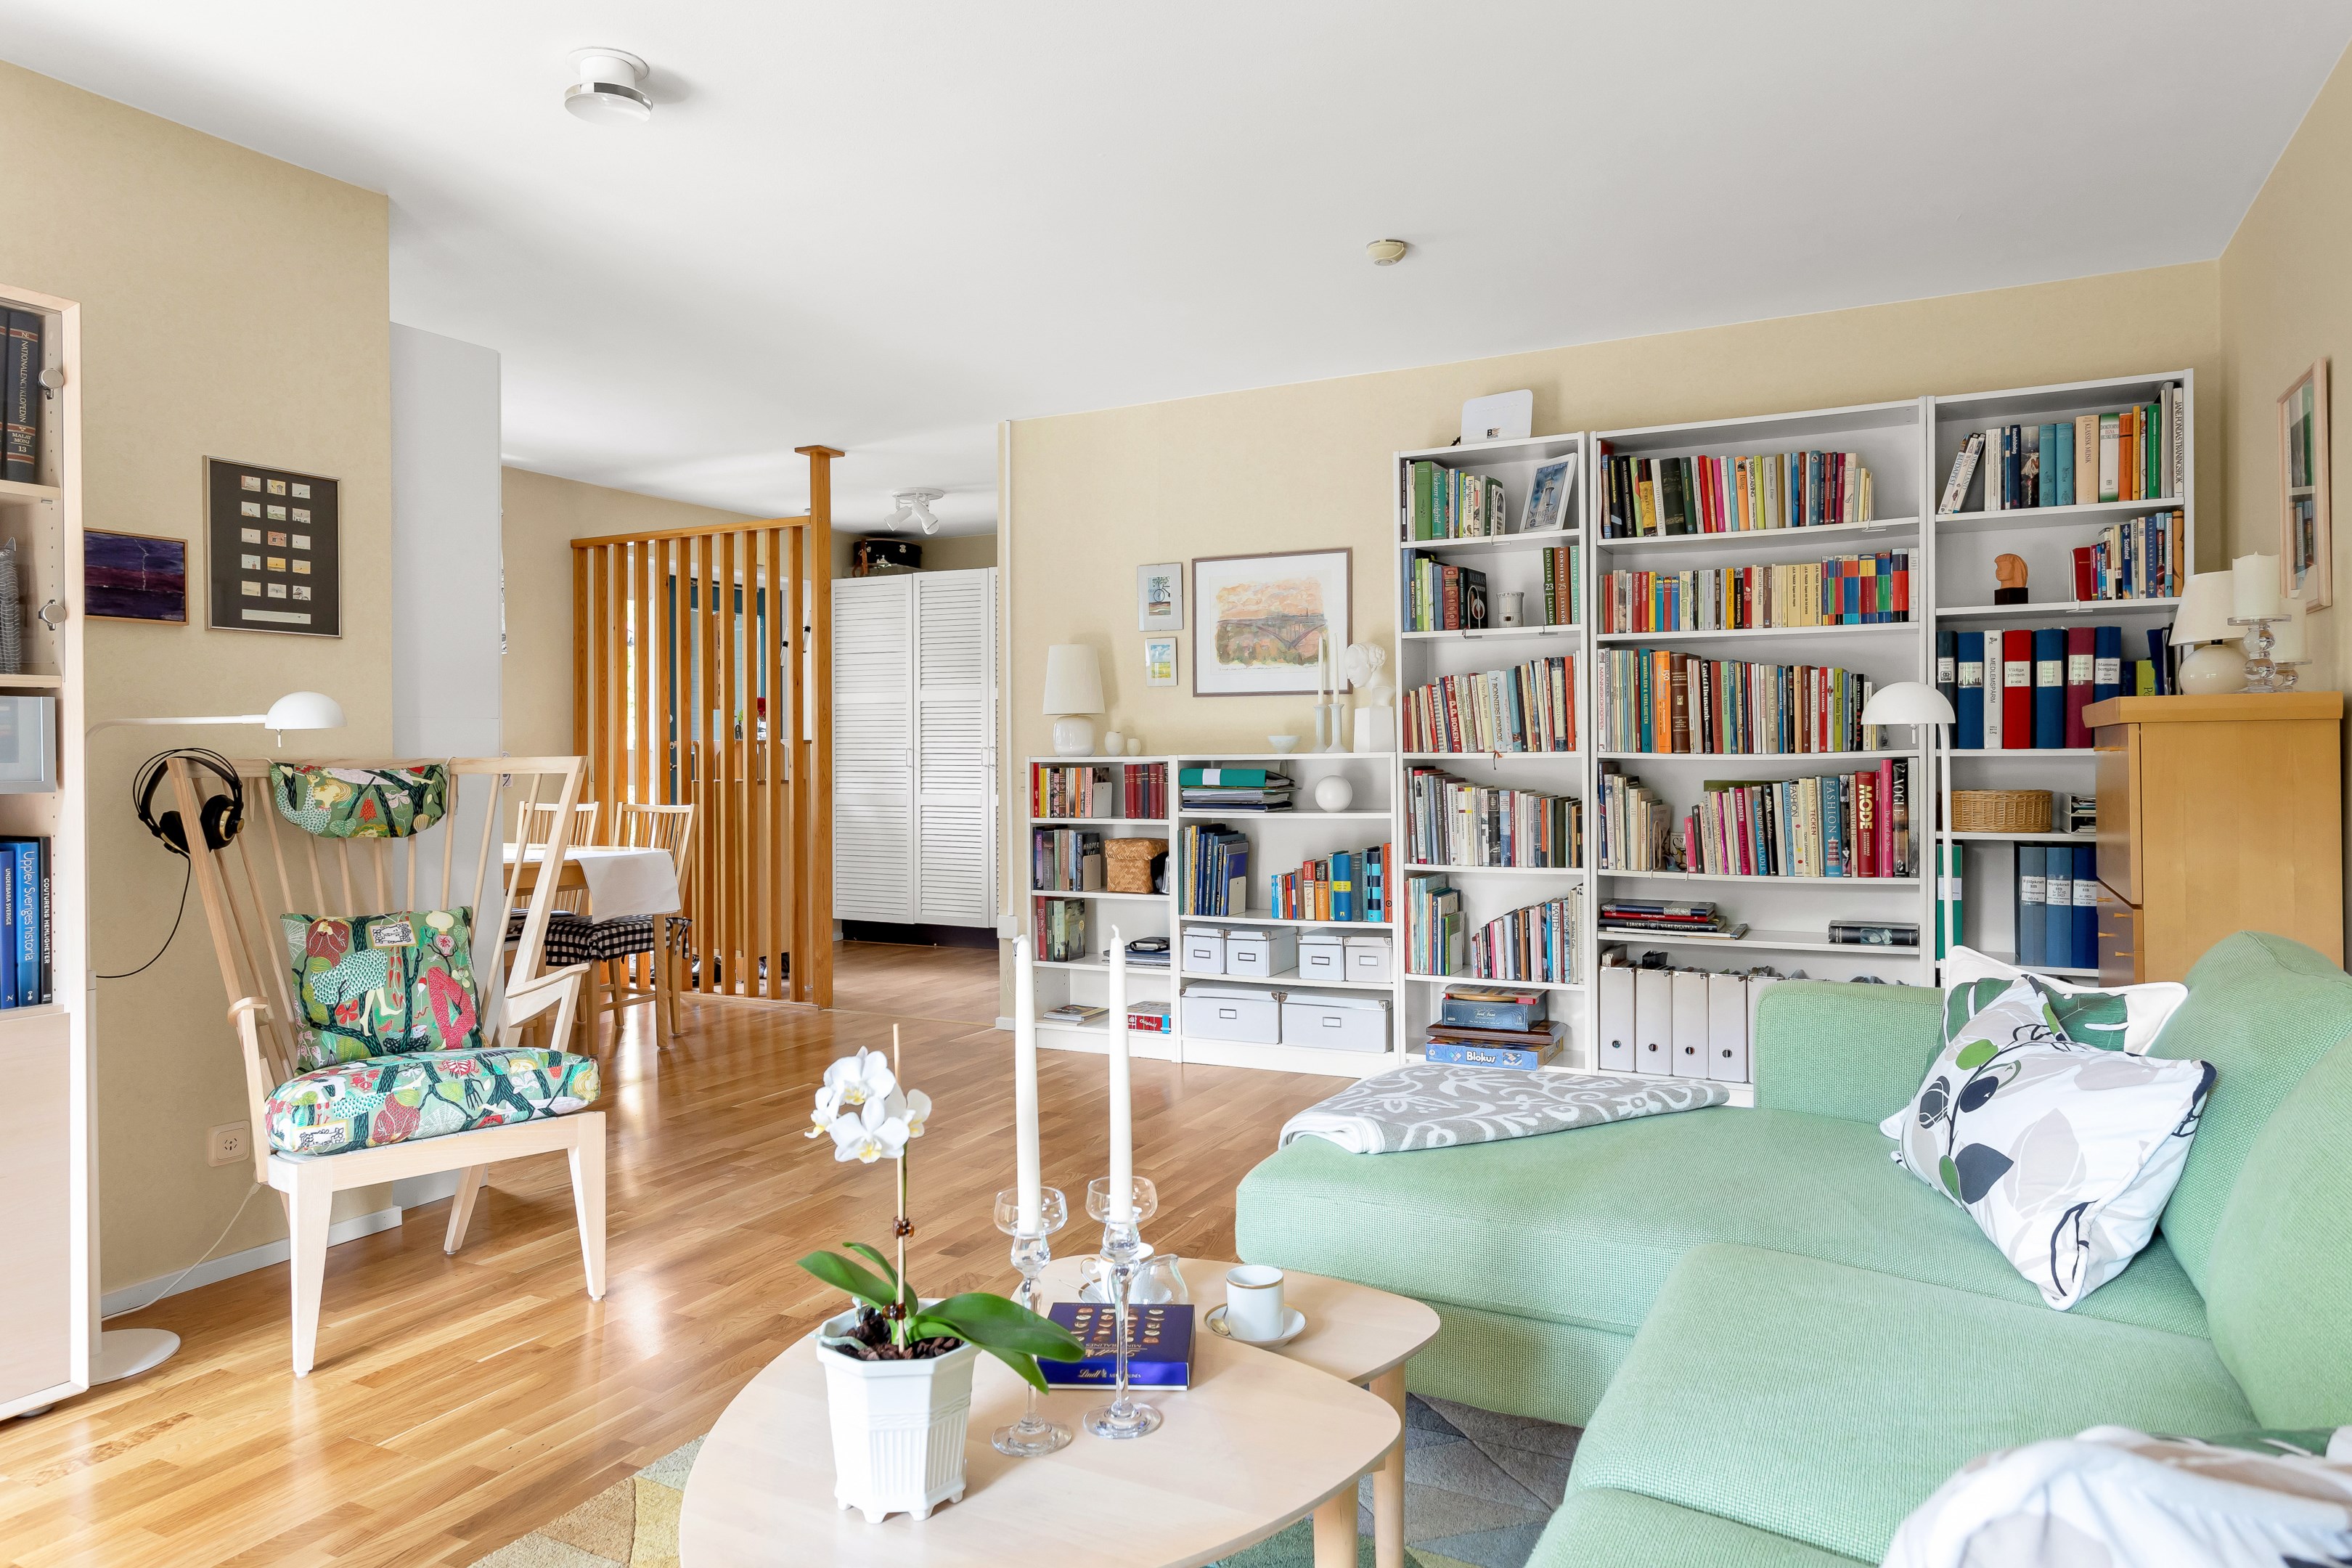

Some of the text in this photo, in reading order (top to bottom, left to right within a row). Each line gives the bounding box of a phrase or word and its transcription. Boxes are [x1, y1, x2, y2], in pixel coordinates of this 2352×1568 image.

[19, 340, 28, 422] NATIONALENCYKLOPEDIN
[1948, 454, 1964, 487] BUDAPEST
[1961, 455, 1979, 490] SKOTTLAND
[1491, 683, 1500, 715] BONNIERS
[1790, 785, 1799, 817] FASHION
[1826, 780, 1837, 834] FASHION
[1858, 784, 1873, 830] MODE
[1892, 778, 1905, 817] VOGUE
[20, 851, 36, 961] Upplev Sveriges historia
[1139, 1018, 1157, 1028] Original
[1466, 1050, 1497, 1063] Blokus
[1078, 1369, 1101, 1378] Lindt
